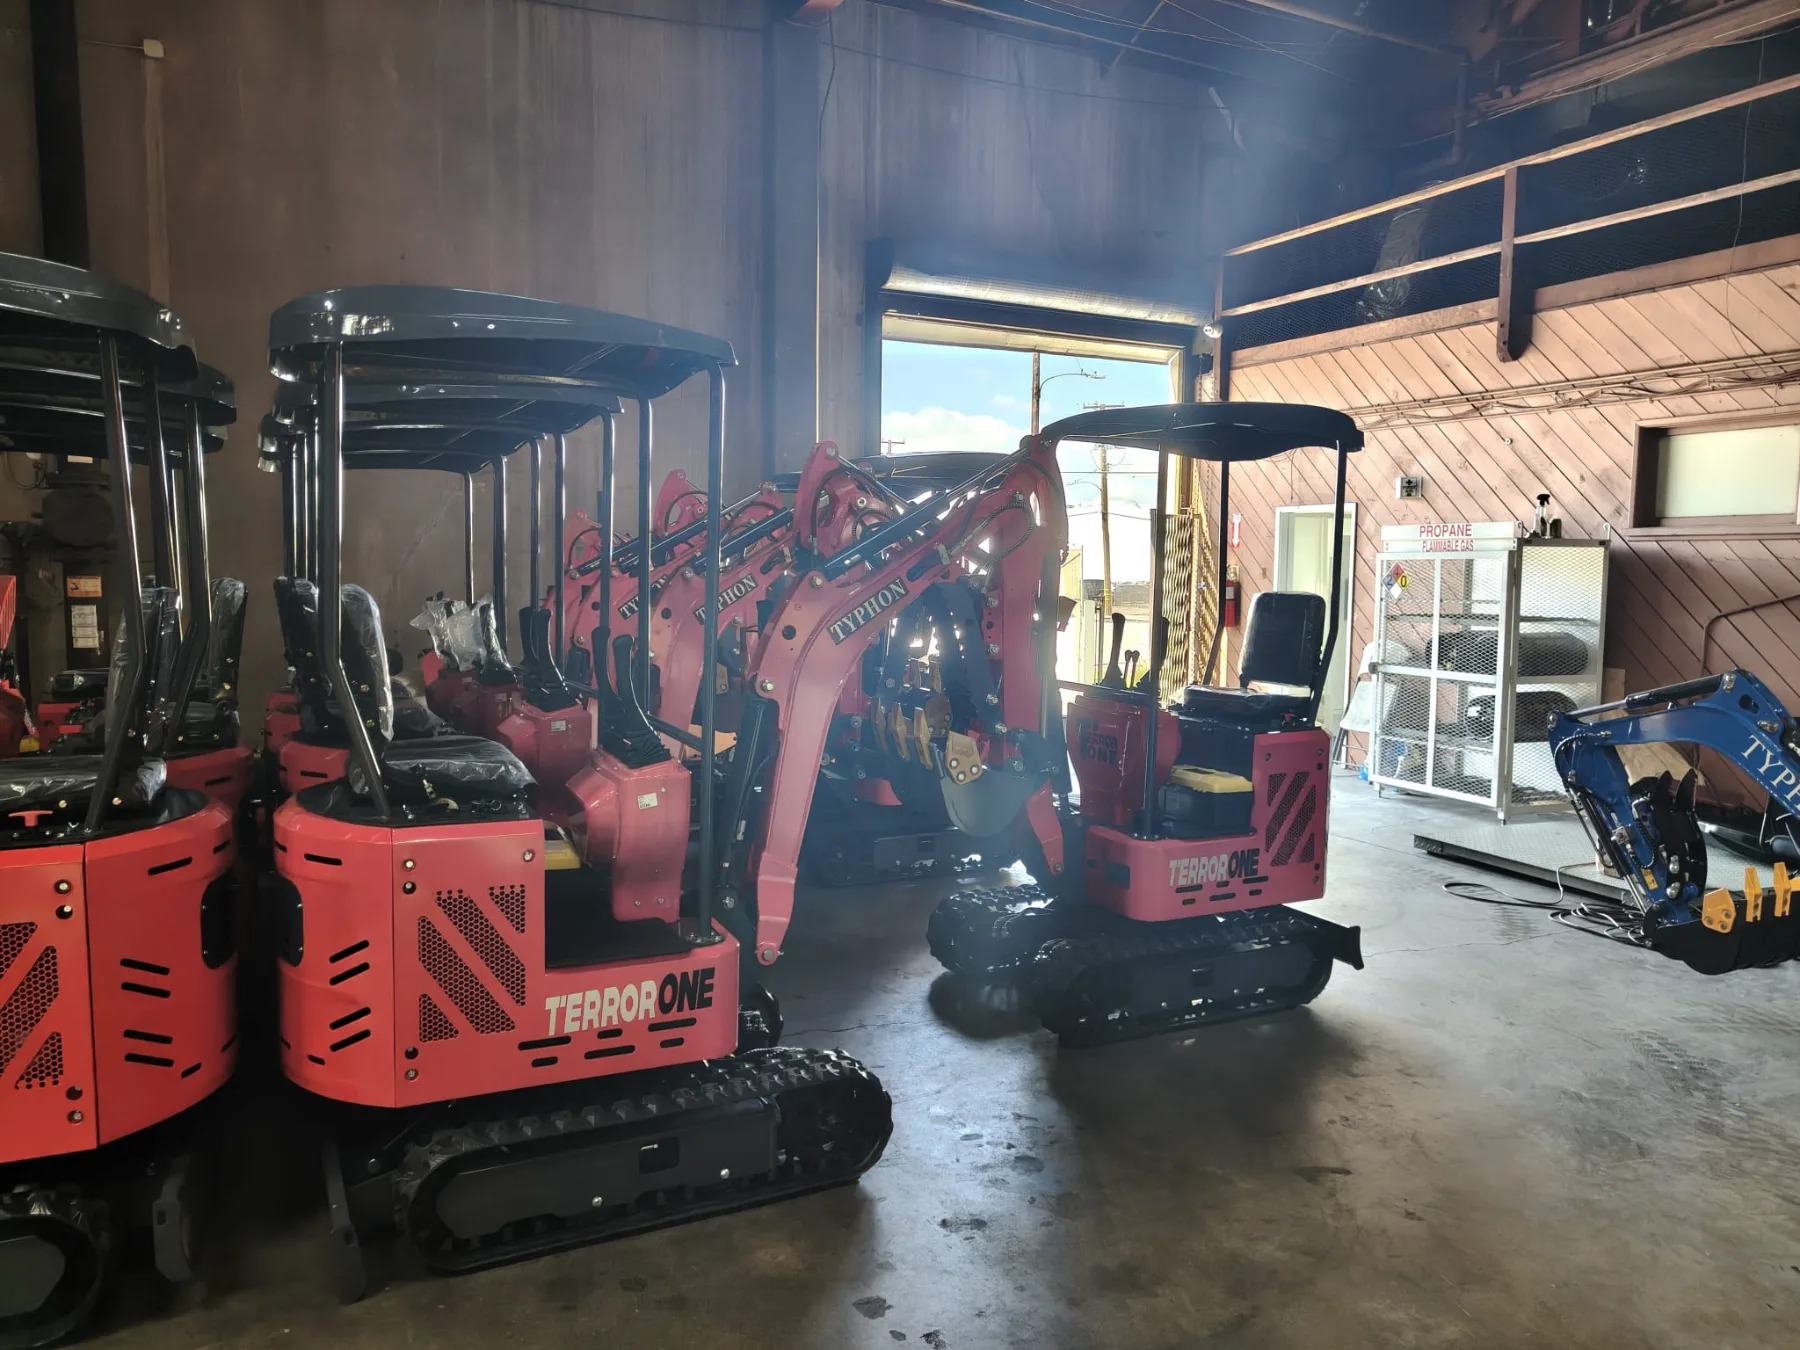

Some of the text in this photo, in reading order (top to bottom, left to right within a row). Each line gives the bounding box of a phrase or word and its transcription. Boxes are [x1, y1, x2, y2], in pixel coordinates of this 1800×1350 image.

[1419, 524, 1472, 537] PROPANE
[1422, 540, 1474, 552] FLAMMABLE GAS
[1386, 575, 1393, 586] 2
[1400, 575, 1407, 587] 0
[695, 575, 757, 620] TPHON
[829, 578, 906, 641] TYPHON
